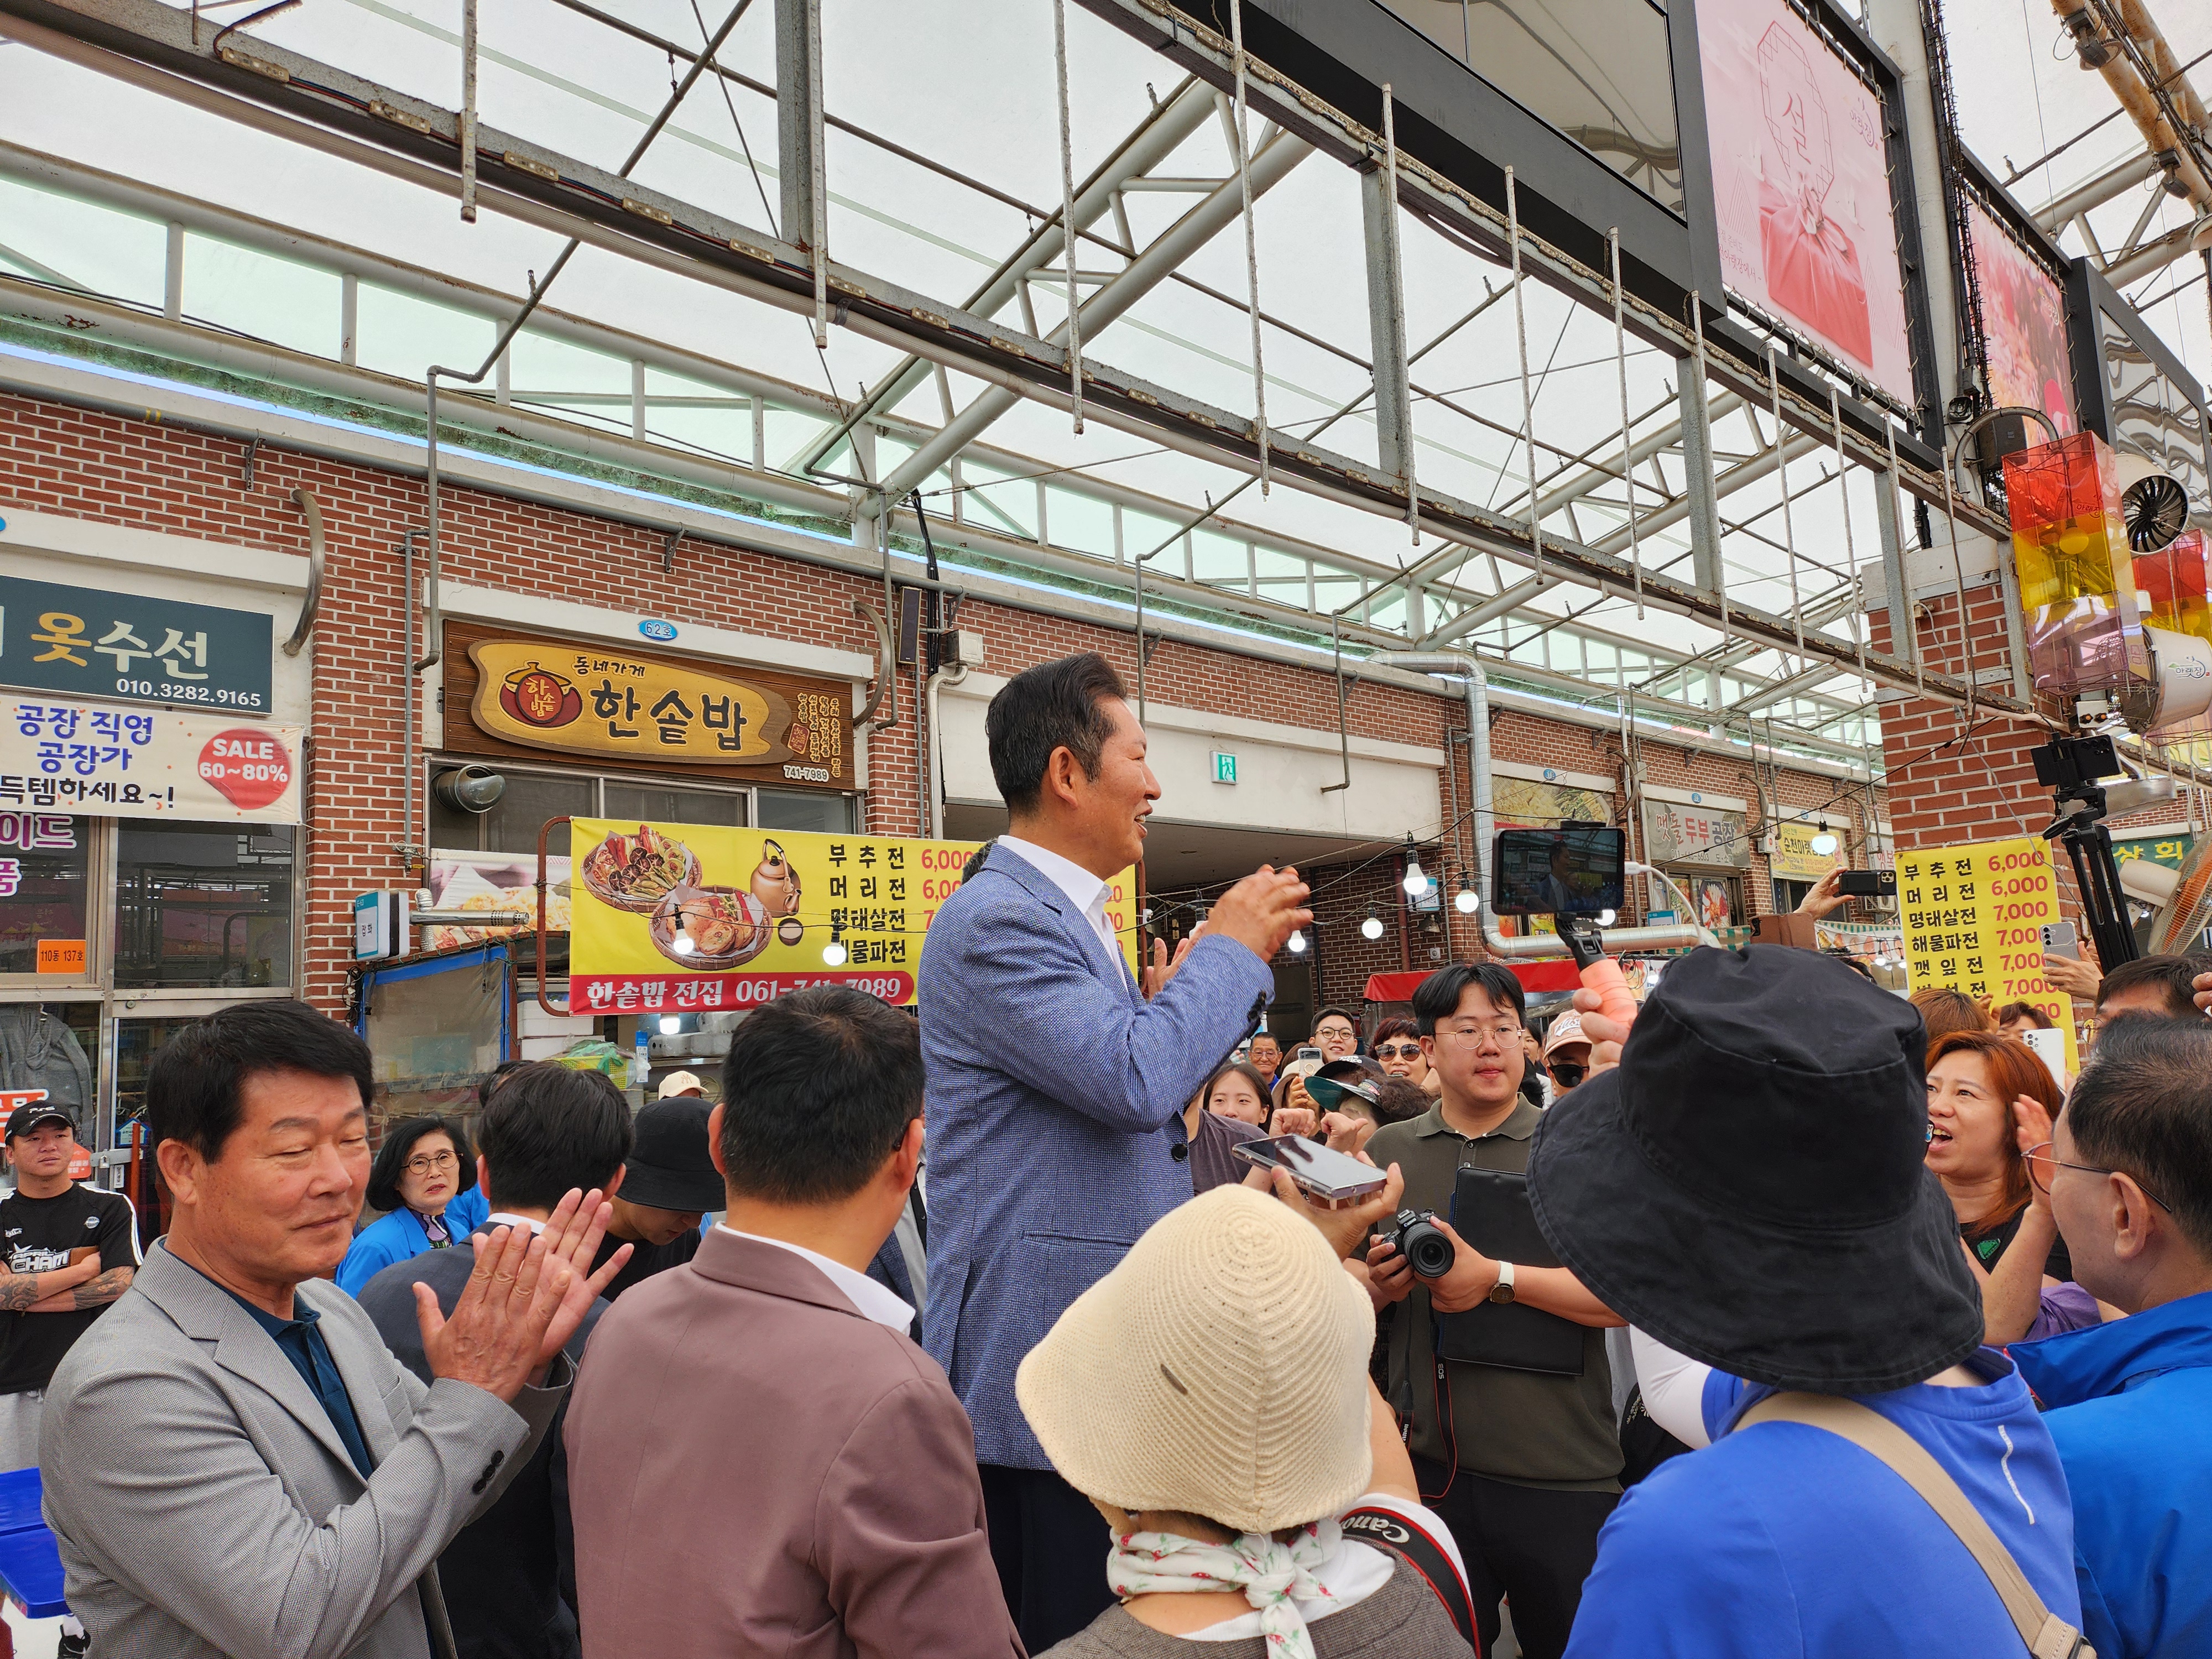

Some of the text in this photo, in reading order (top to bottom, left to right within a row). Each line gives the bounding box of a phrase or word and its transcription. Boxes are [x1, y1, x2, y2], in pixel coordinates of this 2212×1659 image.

[645, 622, 673, 638] 62호
[573, 656, 645, 677] 동네가게
[116, 678, 262, 707] 010.3282.9165
[16, 704, 153, 746] 공장 직영
[590, 679, 747, 751] 한솥밥
[36, 741, 133, 775] 공장가
[212, 738, 274, 761] SALE
[810, 732, 820, 763] 동네가게
[199, 761, 288, 783] 60~80%
[784, 766, 828, 780] 741-7989
[1685, 817, 1710, 846] 두부
[1712, 821, 1735, 849] 공장
[1988, 850, 2045, 873] 6,000
[1991, 875, 2048, 897] 6,000
[1909, 901, 2048, 929] 명태살전 7,000
[1912, 927, 2042, 953] 해물파전 7,00
[40, 950, 84, 962] 110동 137호
[2000, 952, 2046, 972] 7,00
[586, 980, 668, 1009] 한솥밥
[672, 980, 723, 1007] 전집
[1403, 1217, 1417, 1227] Canon
[12, 1250, 55, 1260] APRIL
[1341, 1515, 1411, 1543] Cano
